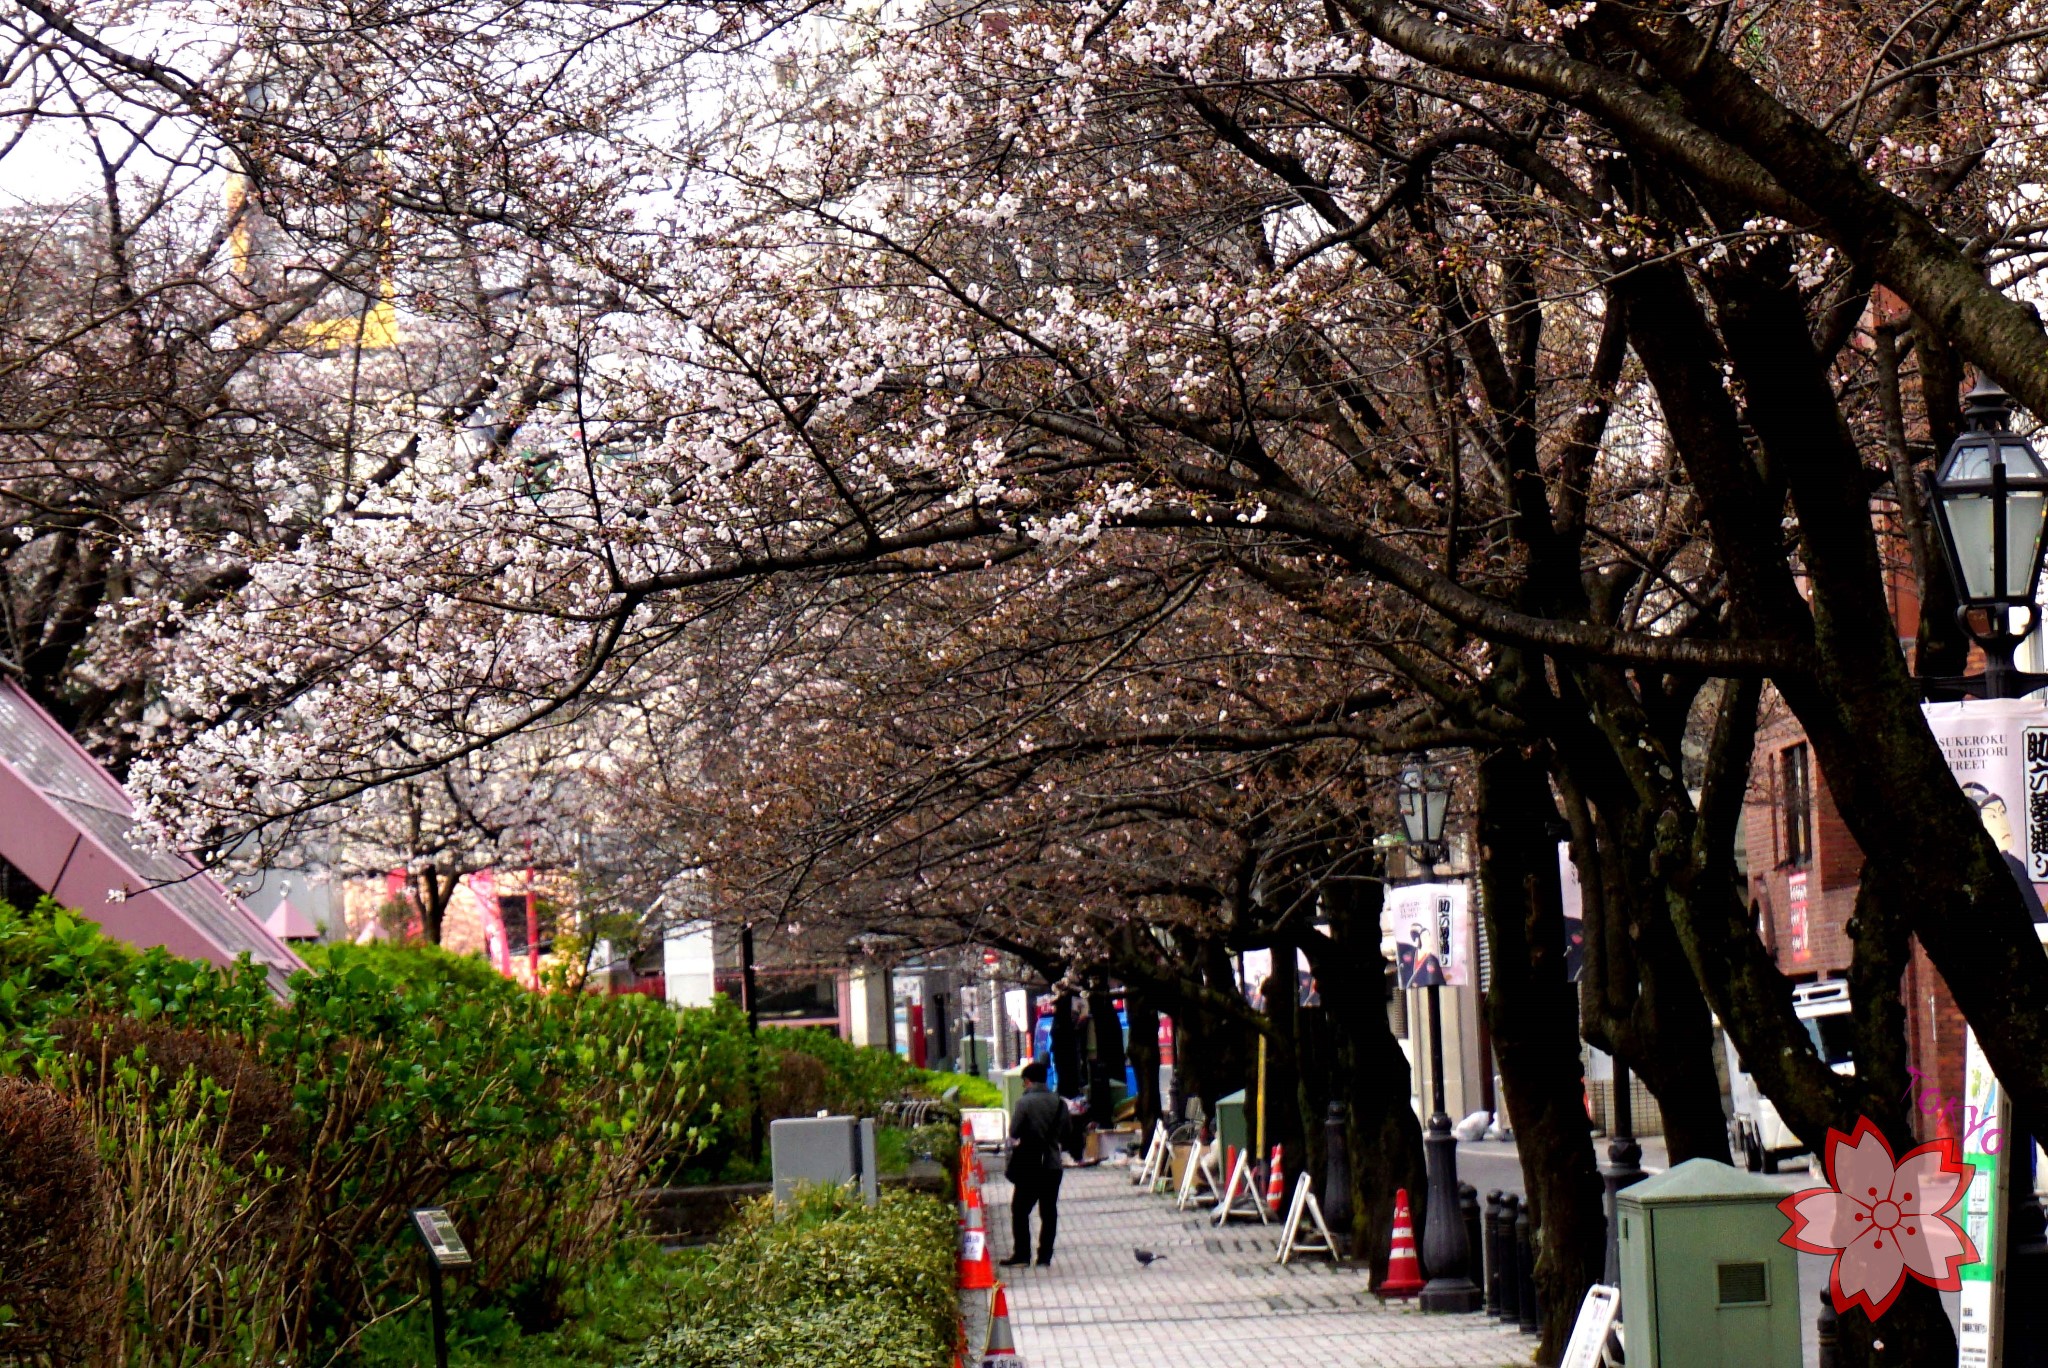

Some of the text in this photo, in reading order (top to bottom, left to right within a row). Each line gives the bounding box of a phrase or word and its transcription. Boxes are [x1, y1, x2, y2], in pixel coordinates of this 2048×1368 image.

[1939, 734, 2008, 747] SUKEROKU
[1944, 746, 2008, 759] UMEDORI
[1949, 759, 1987, 771] TREET
